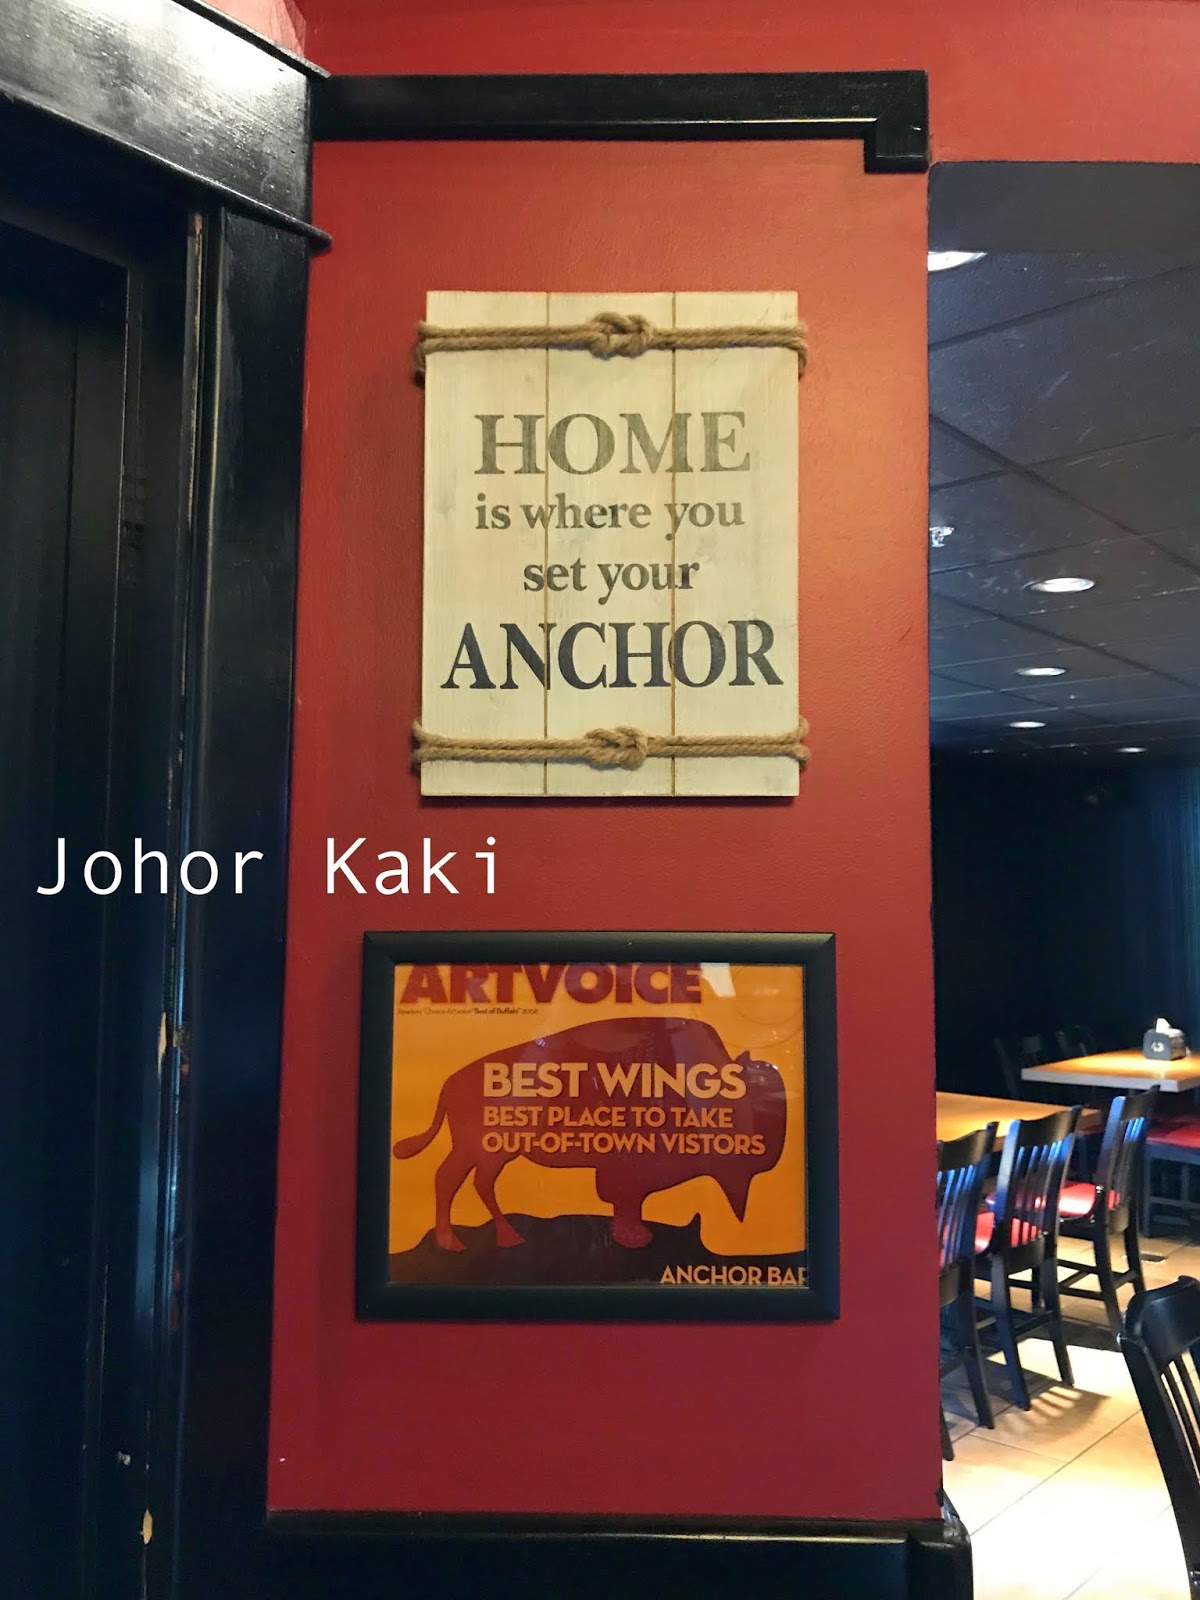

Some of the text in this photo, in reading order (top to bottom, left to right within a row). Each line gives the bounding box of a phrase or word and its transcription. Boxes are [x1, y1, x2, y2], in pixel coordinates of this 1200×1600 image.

[474, 411, 750, 475] HOME
[475, 493, 745, 541] is where you
[523, 557, 700, 605] set your
[440, 619, 784, 690] ANCHOR
[400, 963, 702, 1004] ARTVOICE
[483, 1062, 747, 1099] BEST WINGS
[483, 1106, 734, 1129] BEST PLACE TO TAKE
[482, 1132, 766, 1155] OUT-OF-TOWN VISTORS
[659, 1264, 762, 1286] ANCHOR
